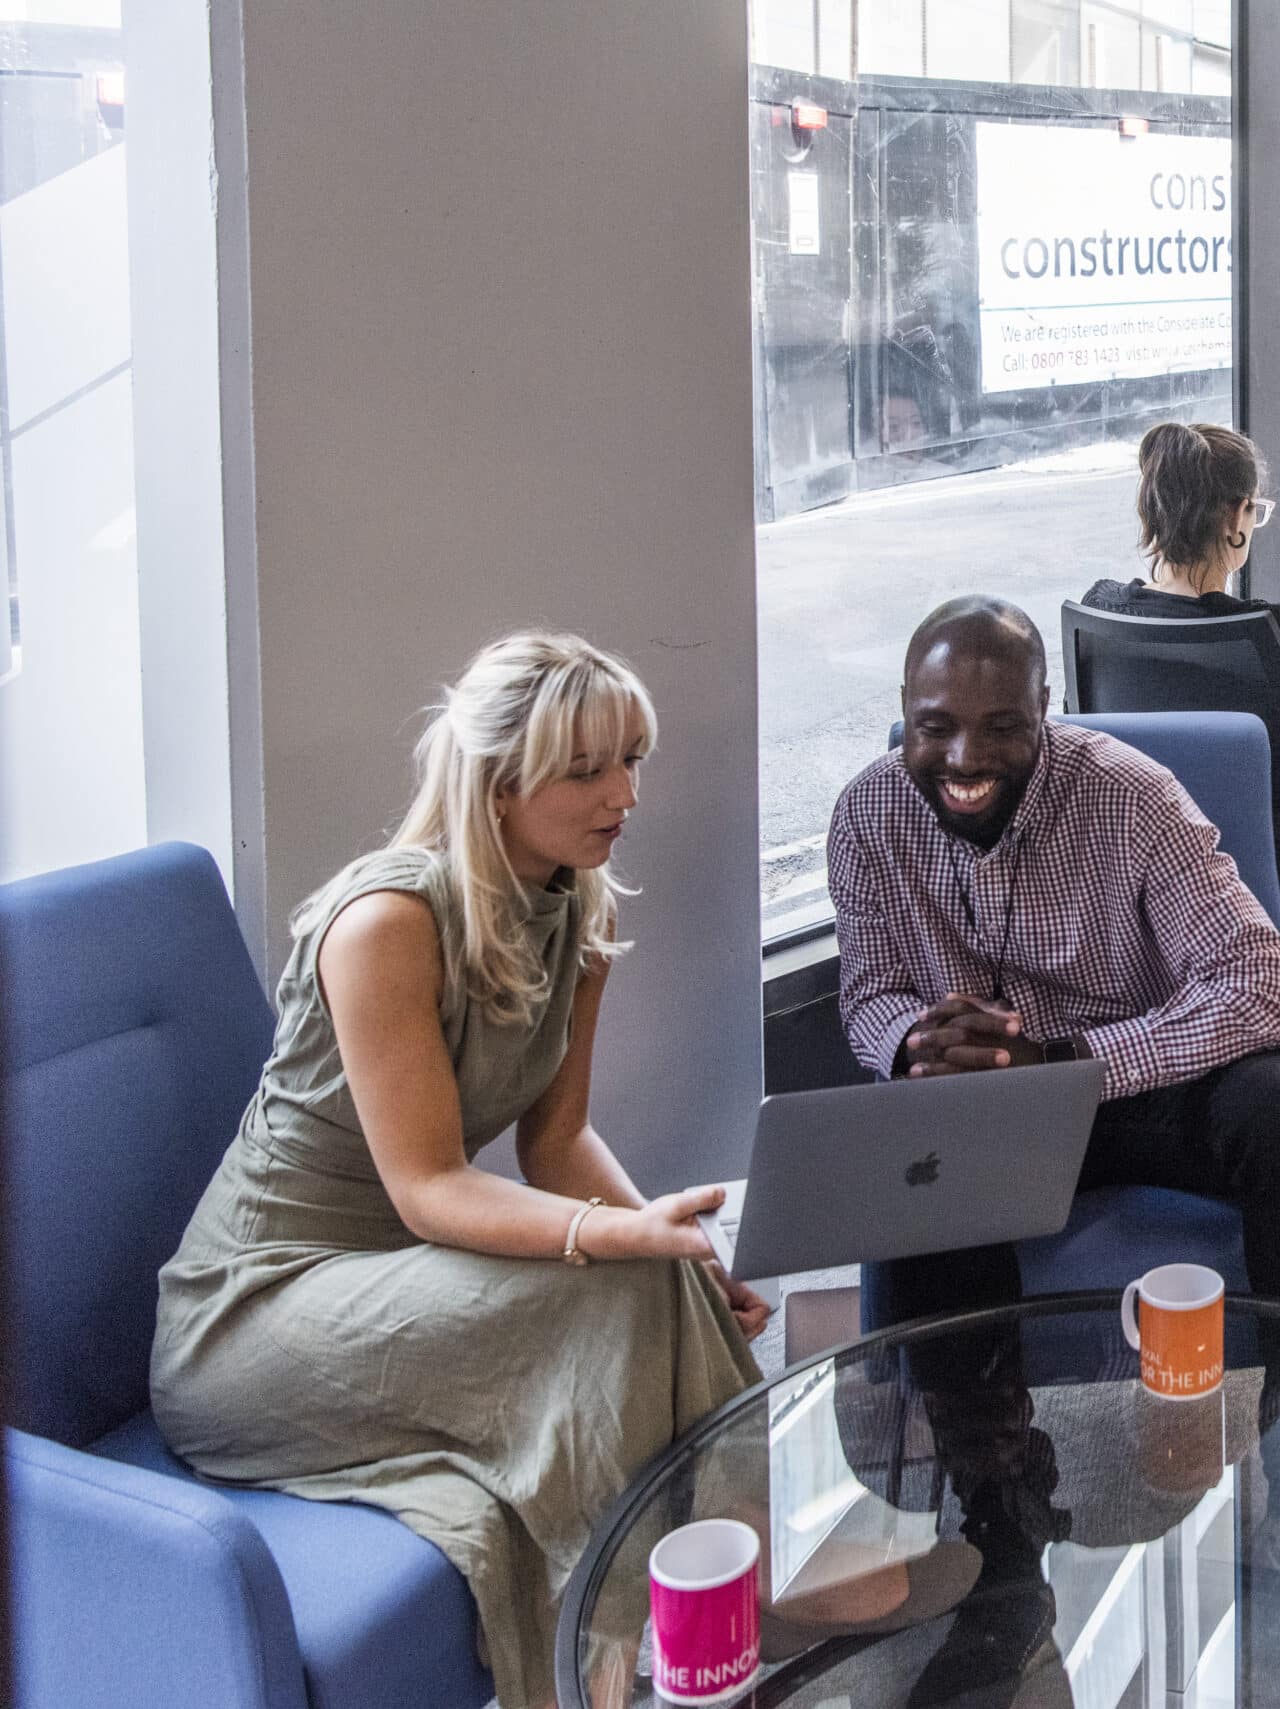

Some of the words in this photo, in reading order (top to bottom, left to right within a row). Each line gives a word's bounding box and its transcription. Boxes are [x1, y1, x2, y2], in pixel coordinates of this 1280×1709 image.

[1000, 320, 1021, 343] We
[1024, 326, 1045, 342] are
[1048, 320, 1109, 344] registered
[1031, 351, 1064, 369] 0800
[1159, 1368, 1194, 1389] THE
[657, 1662, 689, 1689] HE
